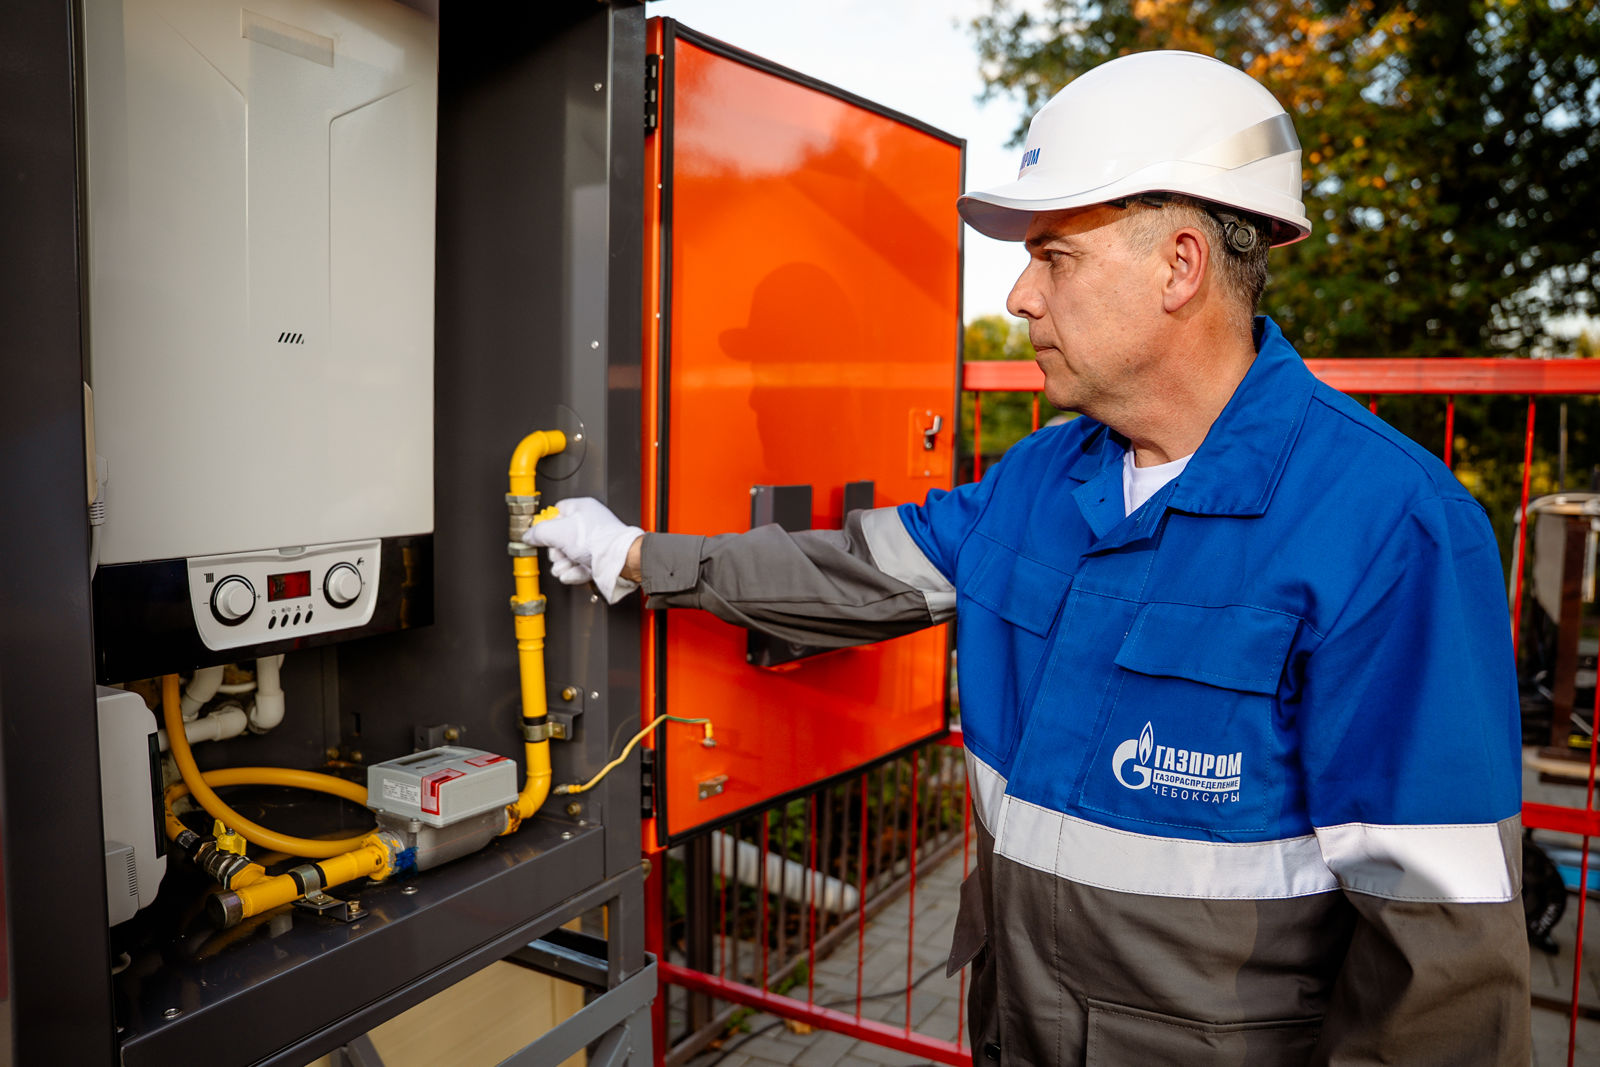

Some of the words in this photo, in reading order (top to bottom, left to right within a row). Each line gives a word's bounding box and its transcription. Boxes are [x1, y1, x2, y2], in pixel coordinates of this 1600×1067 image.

[1154, 745, 1242, 777] ГАЗПРОМ
[1155, 772, 1239, 790] ГАЗОРАСПРЕДЕЛЕНИЕ
[1151, 784, 1240, 804] ЧЕБОКСАРЫ
